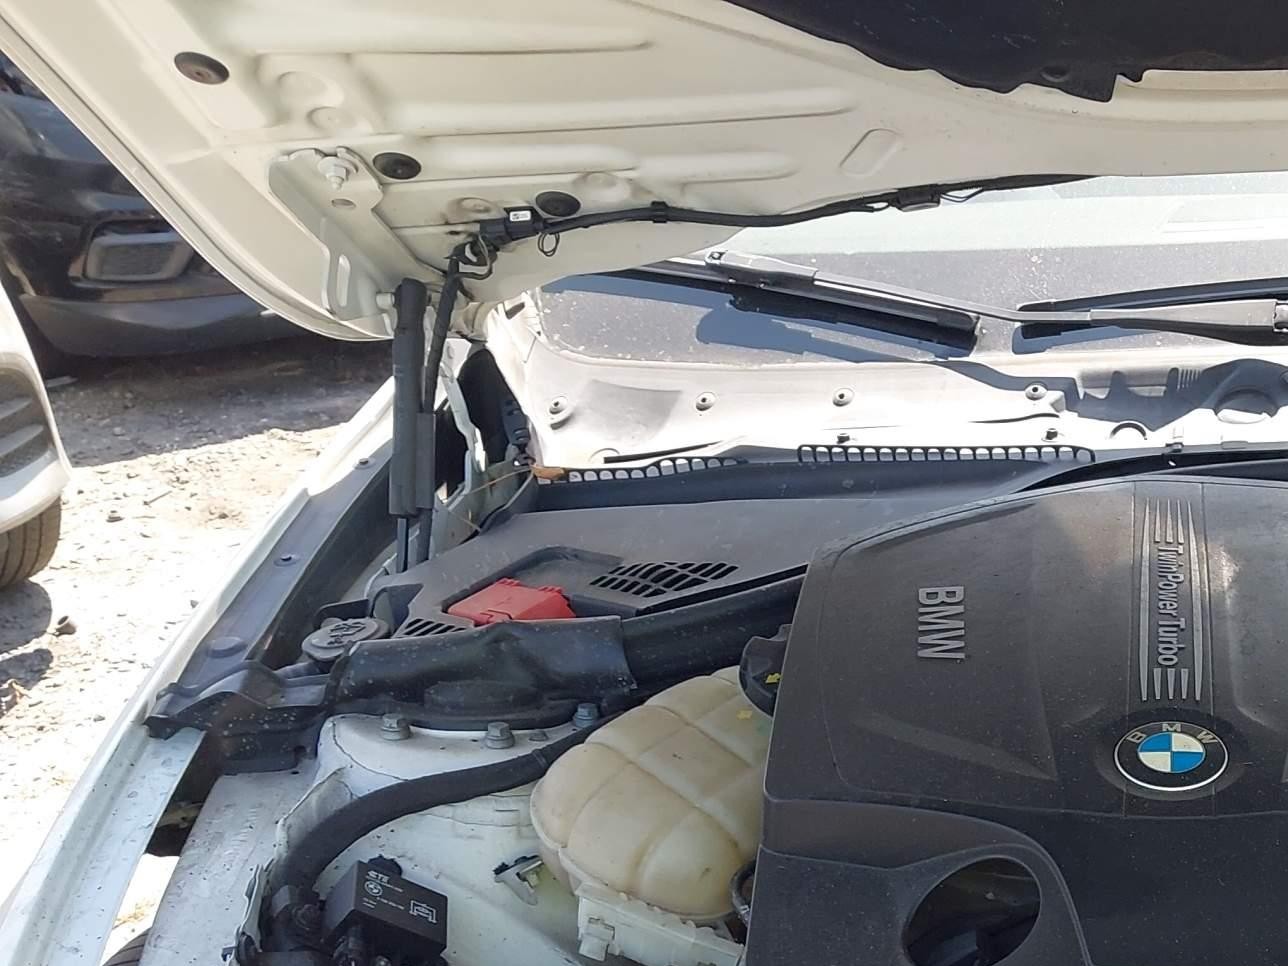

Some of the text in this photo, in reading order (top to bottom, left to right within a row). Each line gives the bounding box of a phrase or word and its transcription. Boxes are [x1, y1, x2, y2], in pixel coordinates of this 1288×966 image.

[917, 585, 966, 659] BMW
[1157, 545, 1186, 666] TwinPower Turbo
[1126, 722, 1218, 744] BMW
